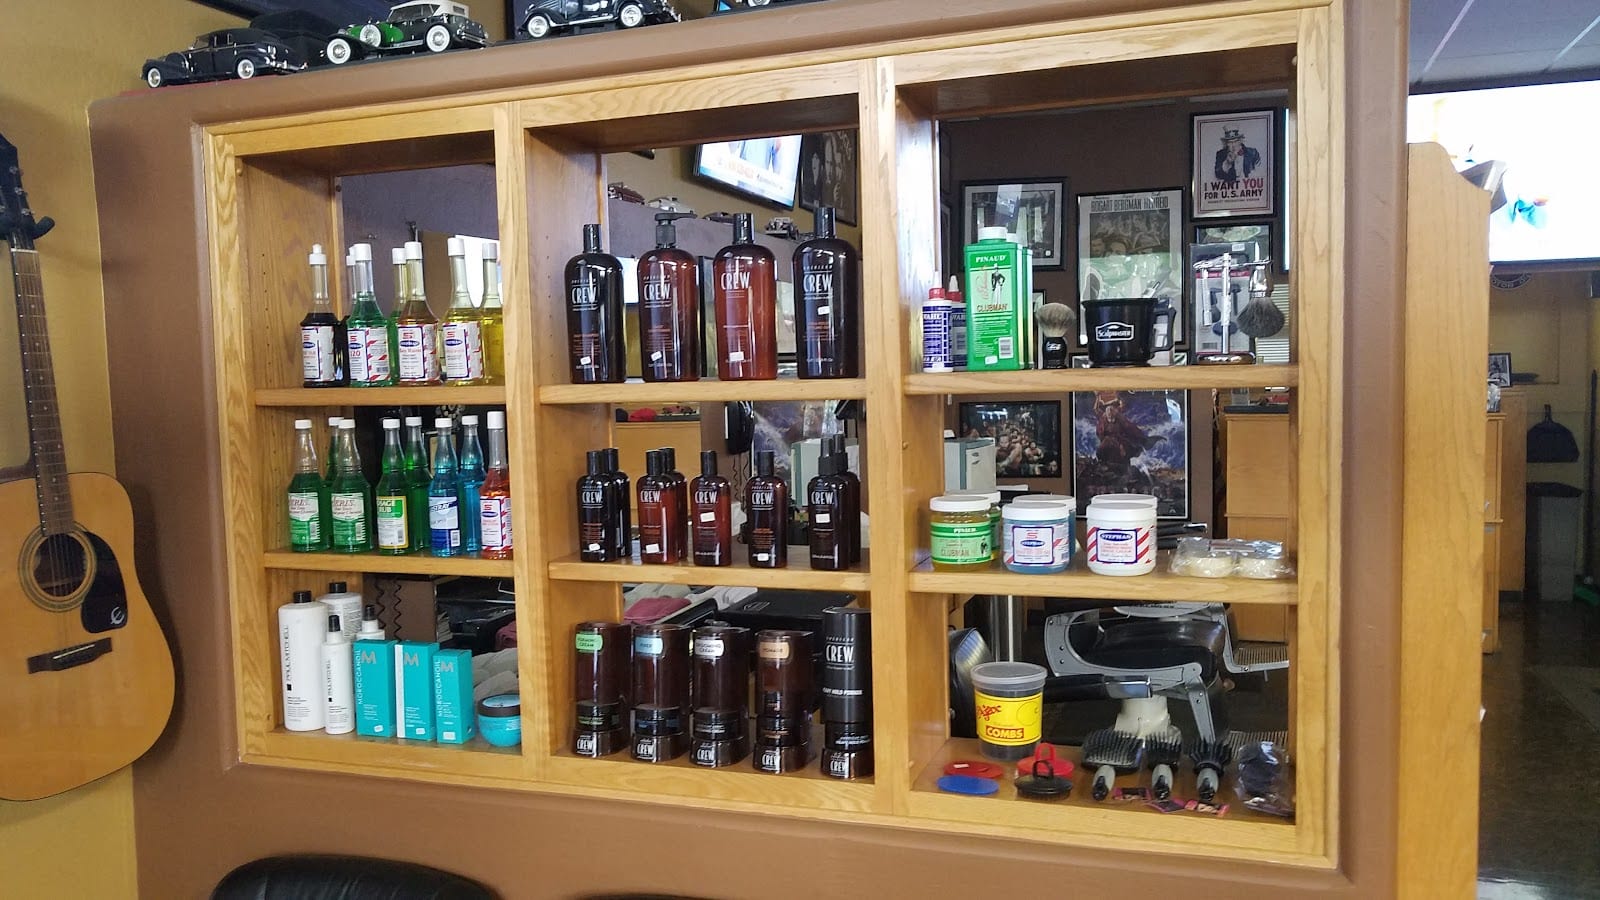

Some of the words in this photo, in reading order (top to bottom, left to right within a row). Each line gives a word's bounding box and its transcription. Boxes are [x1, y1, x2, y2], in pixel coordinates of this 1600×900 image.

[1204, 182, 1208, 191] I
[1211, 180, 1240, 191] WANT
[1242, 178, 1264, 189] YOU
[1204, 191, 1218, 200] FOR
[1221, 190, 1239, 199] U.S.
[1240, 189, 1264, 197] ARMY
[975, 255, 1007, 263] PINAUD
[720, 272, 751, 290] CREW
[803, 274, 833, 292] CREW
[571, 287, 597, 304] CREW
[643, 283, 671, 300] CREW
[976, 303, 1008, 313] CLUBMAN
[582, 491, 603, 504] CREW
[640, 490, 662, 503] CREW
[695, 491, 718, 504] CREW
[752, 491, 774, 505] CREW
[811, 491, 834, 505] CREW
[360, 651, 376, 665] M
[403, 652, 419, 667] M
[826, 645, 854, 662] CREW
[440, 661, 454, 673] M
[355, 650, 363, 705] MOROCCANOIL
[434, 660, 443, 717] MOROCCANOIL
[987, 727, 1023, 739] COMBS
[577, 738, 595, 751] CREW
[637, 743, 656, 755] CREW
[697, 748, 715, 761] CREW
